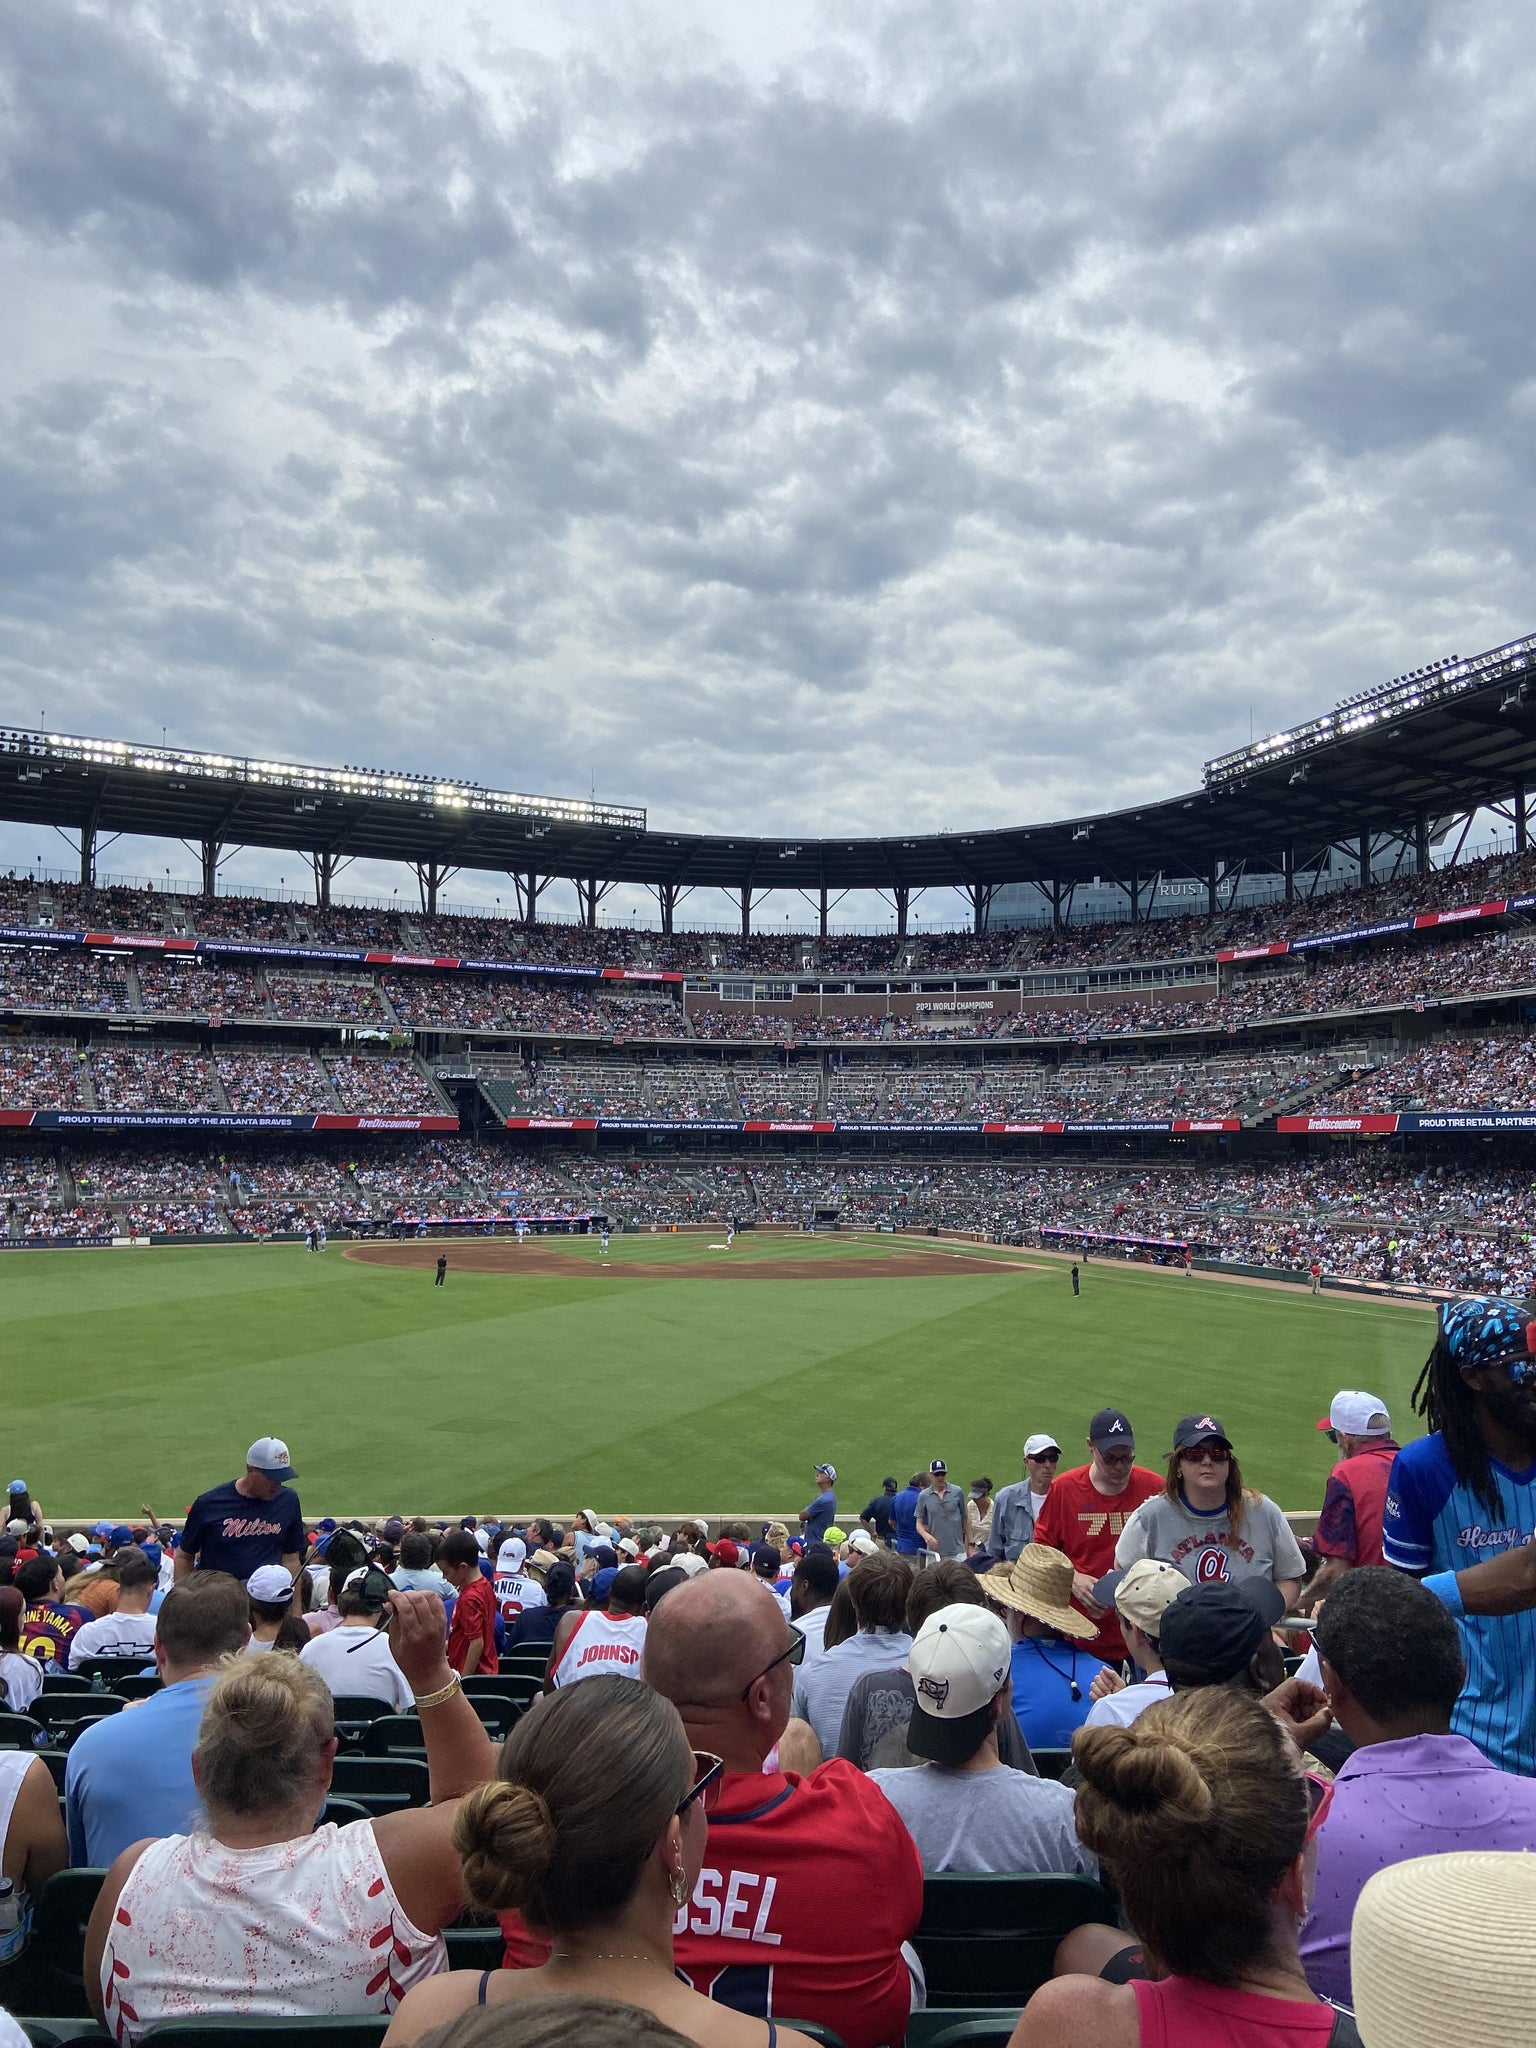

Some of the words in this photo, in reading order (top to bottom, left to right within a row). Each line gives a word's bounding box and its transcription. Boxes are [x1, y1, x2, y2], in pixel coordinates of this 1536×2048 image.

[1514, 899, 1534, 908] PROUD
[112, 937, 166, 947] TireDiscounters
[916, 1002, 932, 1011] 2021
[933, 1002, 955, 1010] WORLD
[957, 1001, 994, 1010] CHAMPIONS
[358, 1118, 421, 1128] TireDiscounters
[528, 1120, 573, 1128] TireDiscounters
[1308, 1118, 1362, 1129] TireDiscounters
[1419, 1119, 1446, 1127] PROUD
[1447, 1118, 1465, 1127] TIRE
[1466, 1118, 1495, 1126] RETAIL
[1496, 1117, 1536, 1126] PARTNER
[1109, 1419, 1123, 1432] A
[222, 1518, 281, 1538] Milton
[1078, 1512, 1134, 1535] 71
[1456, 1526, 1519, 1550] Heavy
[43, 1610, 73, 1637] YAMAL
